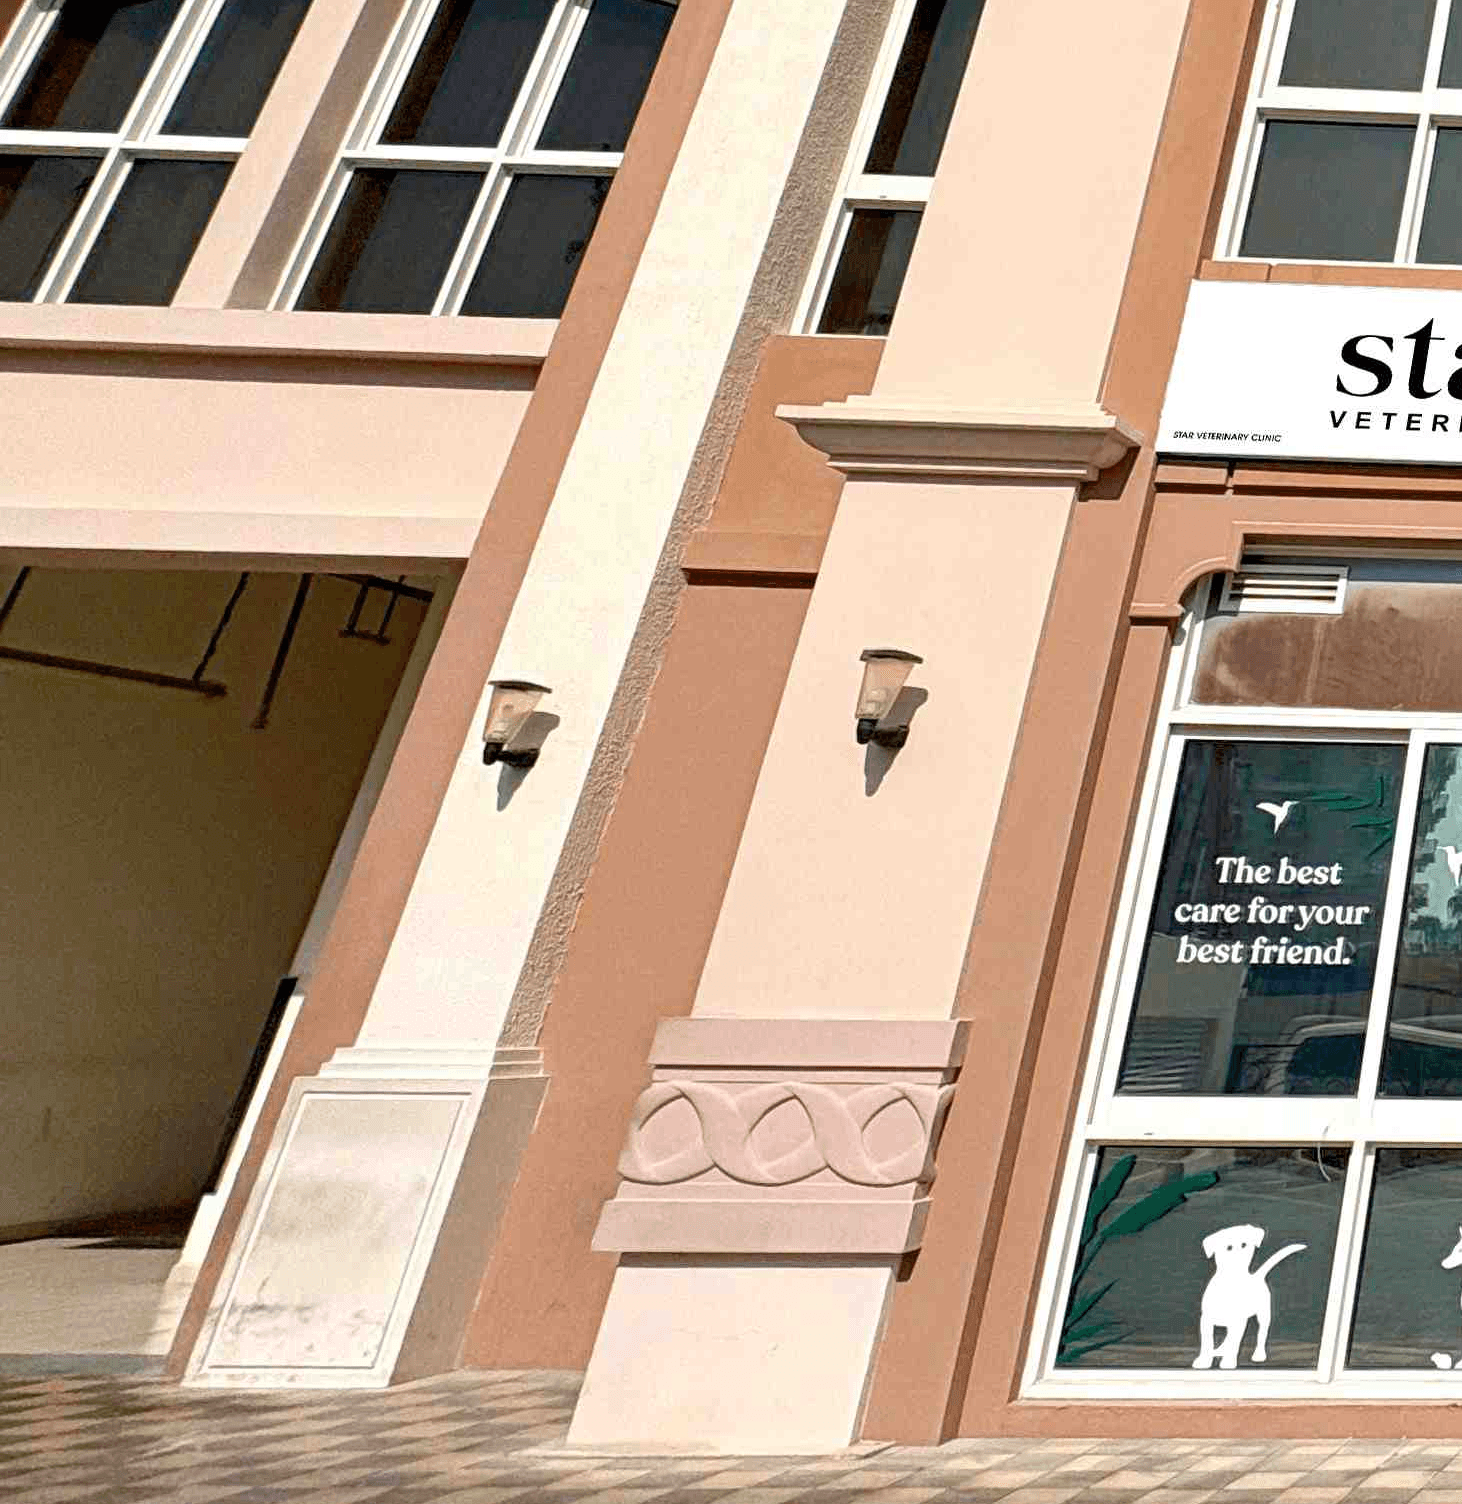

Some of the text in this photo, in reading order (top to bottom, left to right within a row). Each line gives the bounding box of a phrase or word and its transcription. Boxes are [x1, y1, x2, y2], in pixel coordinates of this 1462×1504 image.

[1173, 430, 1282, 443] STAR VETERINARY CLINIC
[1215, 856, 1343, 885] The best
[1174, 896, 1370, 931] care for your
[1176, 934, 1352, 965] best friend.
